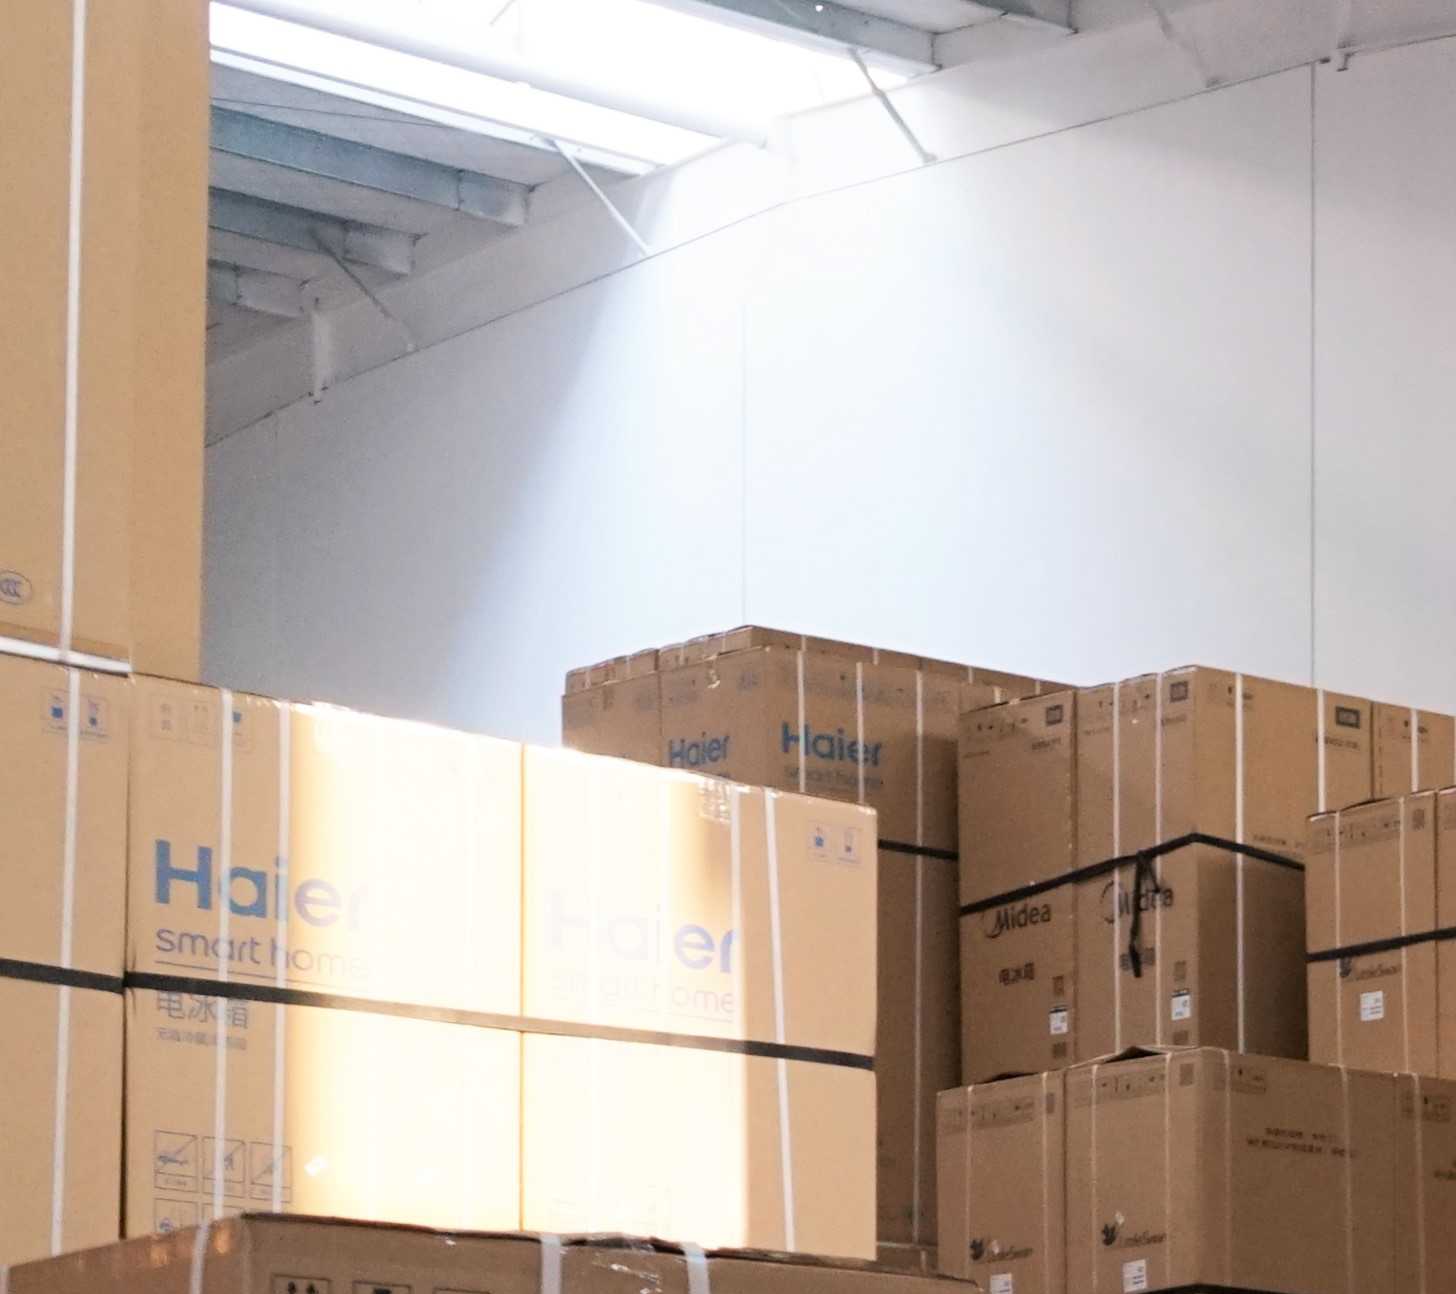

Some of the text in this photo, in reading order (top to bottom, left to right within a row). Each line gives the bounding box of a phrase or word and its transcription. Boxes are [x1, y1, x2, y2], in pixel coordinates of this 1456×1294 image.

[668, 731, 731, 766] Haier
[781, 722, 882, 767] Haier
[985, 902, 1050, 940] Midea
